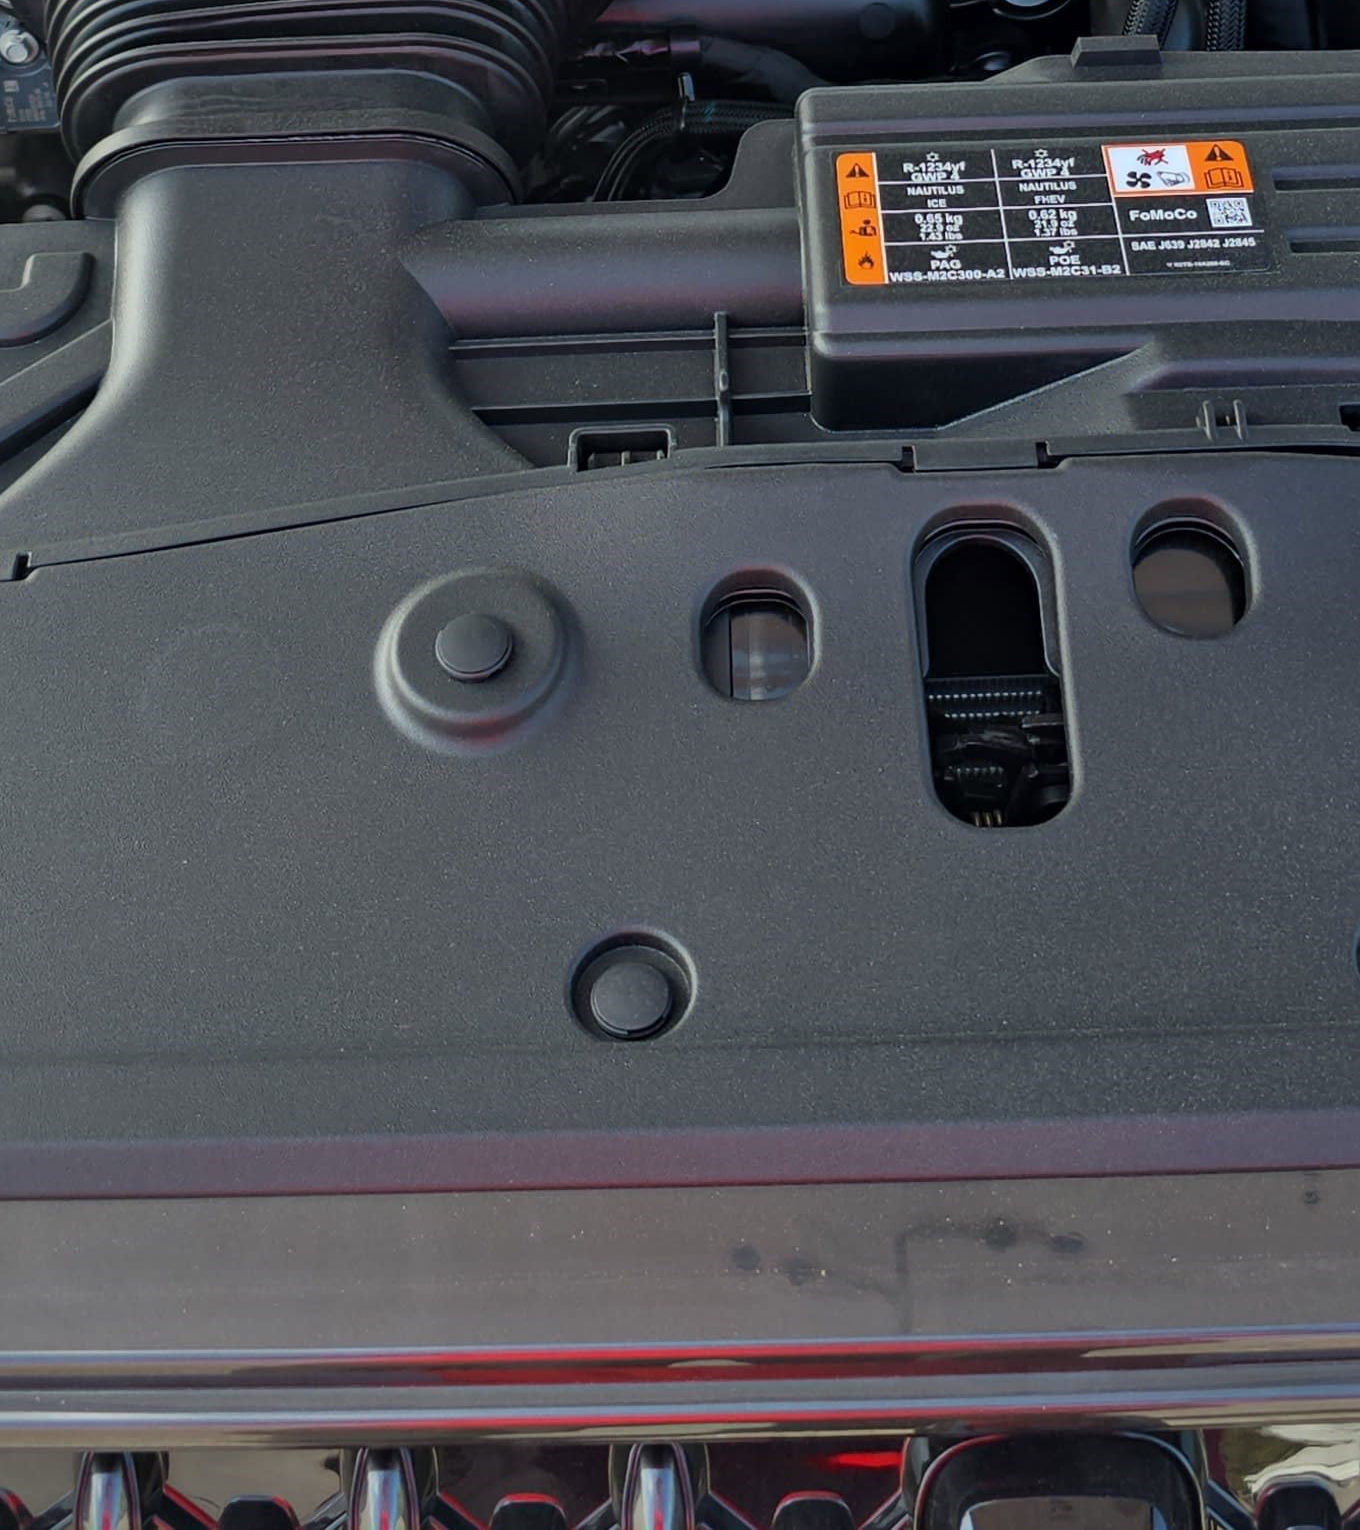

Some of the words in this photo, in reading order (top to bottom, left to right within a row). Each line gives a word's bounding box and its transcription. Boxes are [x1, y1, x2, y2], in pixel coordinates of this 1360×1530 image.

[903, 161, 965, 174] R-1234yf
[1012, 158, 1075, 171] R-1234yf
[911, 172, 947, 182] GWP
[907, 185, 965, 195] NAUTILUS
[1019, 181, 1077, 192] NAUTILUS
[927, 199, 947, 208] ICE
[914, 213, 942, 224] 0.65
[945, 213, 963, 226] kg
[1028, 209, 1057, 221] 0.62
[1059, 209, 1077, 222] kg
[1129, 208, 1198, 221] FoMoCo
[920, 224, 943, 232] 22.9
[1034, 220, 1058, 228] 21.9
[1060, 220, 1074, 228] oz
[919, 232, 943, 241] 1.43
[945, 232, 963, 241] lbs
[1034, 228, 1057, 237] 1.37
[1060, 228, 1078, 236] lbs
[1131, 241, 1156, 251] SAE
[930, 260, 961, 270] PAG
[1049, 255, 1081, 265] POE
[890, 269, 1006, 282] WSS-M2C300-A2
[1013, 265, 1121, 278] WSS-M2C31-B2
